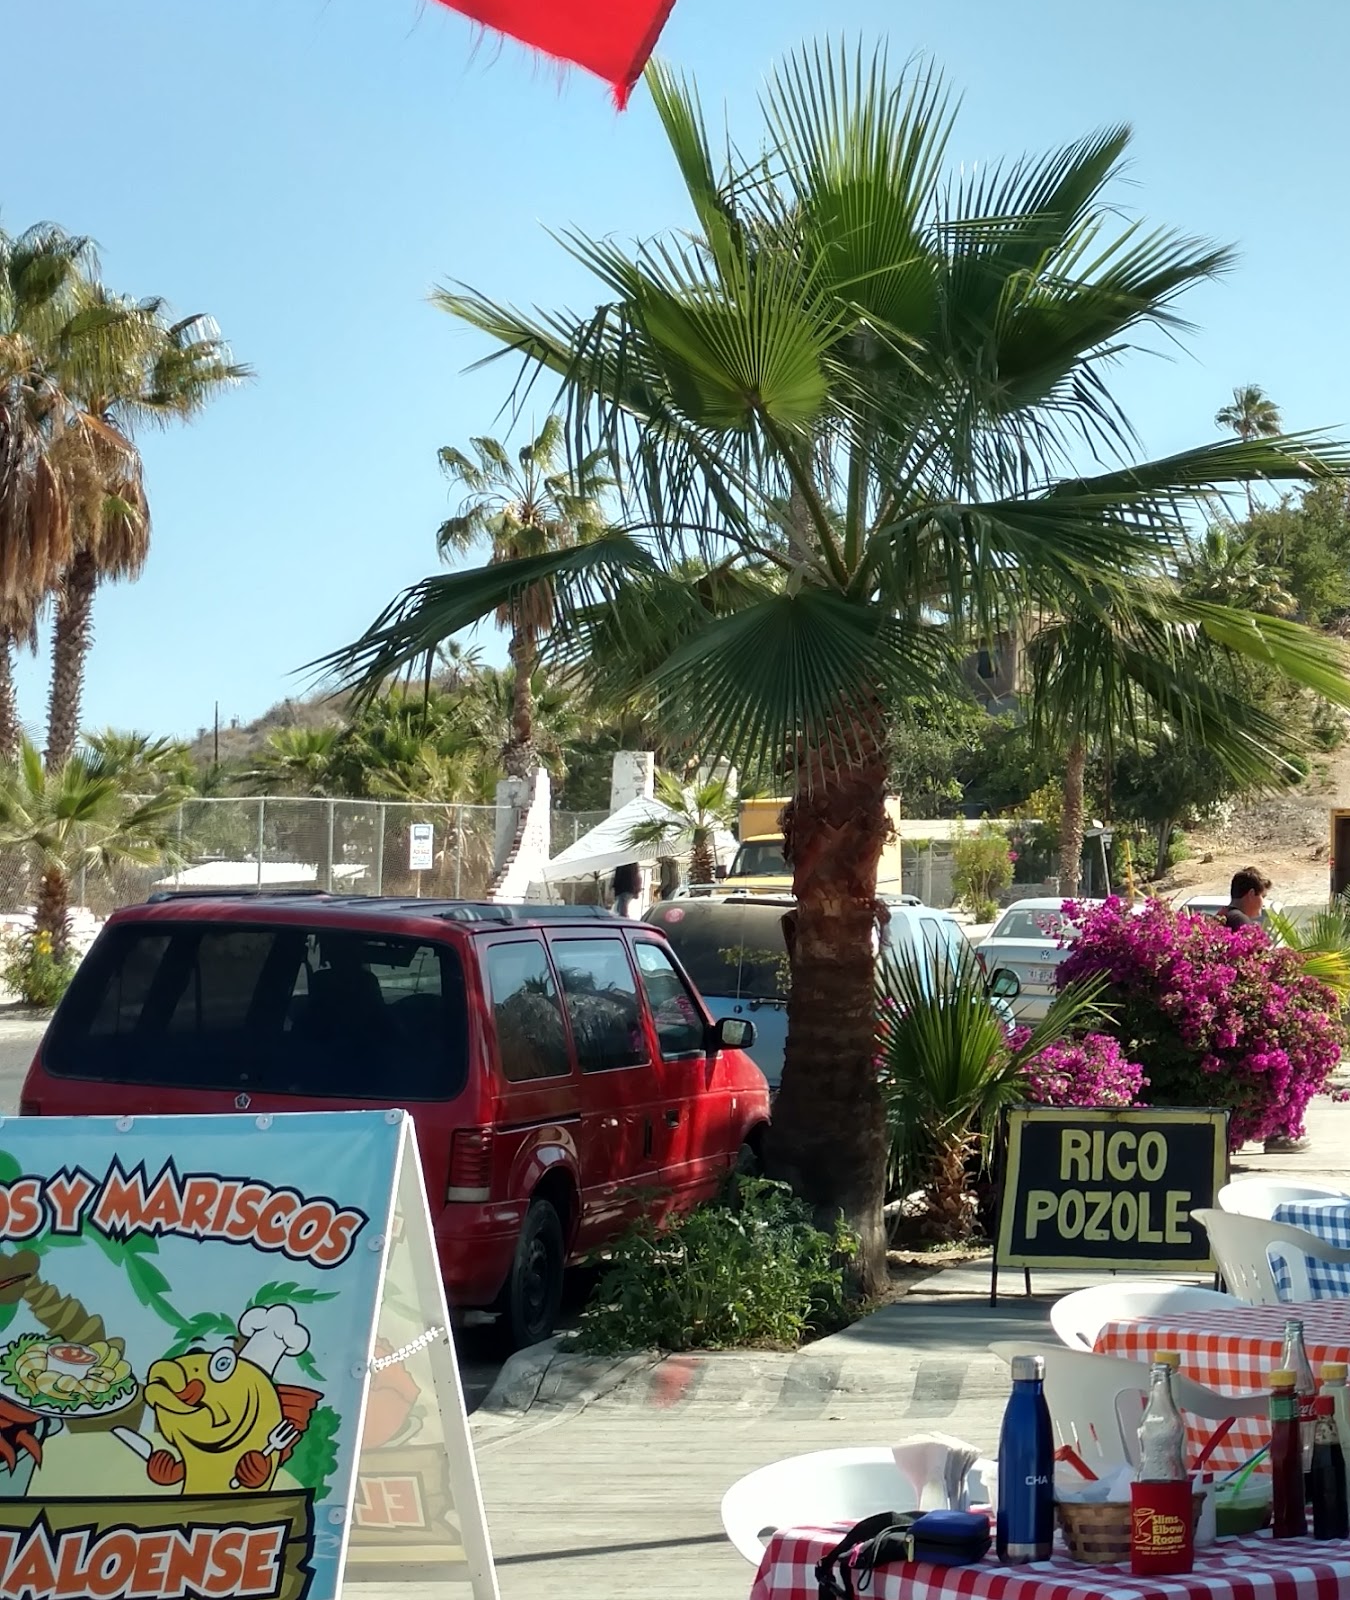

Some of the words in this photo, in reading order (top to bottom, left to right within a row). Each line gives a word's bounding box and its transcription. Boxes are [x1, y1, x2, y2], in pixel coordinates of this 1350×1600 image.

[1060, 1128, 1168, 1182] RICO
[0, 1178, 42, 1236] S
[46, 1169, 96, 1234] Y
[93, 1164, 364, 1264] MARISCOS
[1025, 1189, 1192, 1244] POZOLE
[1152, 1514, 1179, 1525] Slims
[1152, 1525, 1184, 1535] Elbow
[1152, 1535, 1183, 1545] Room
